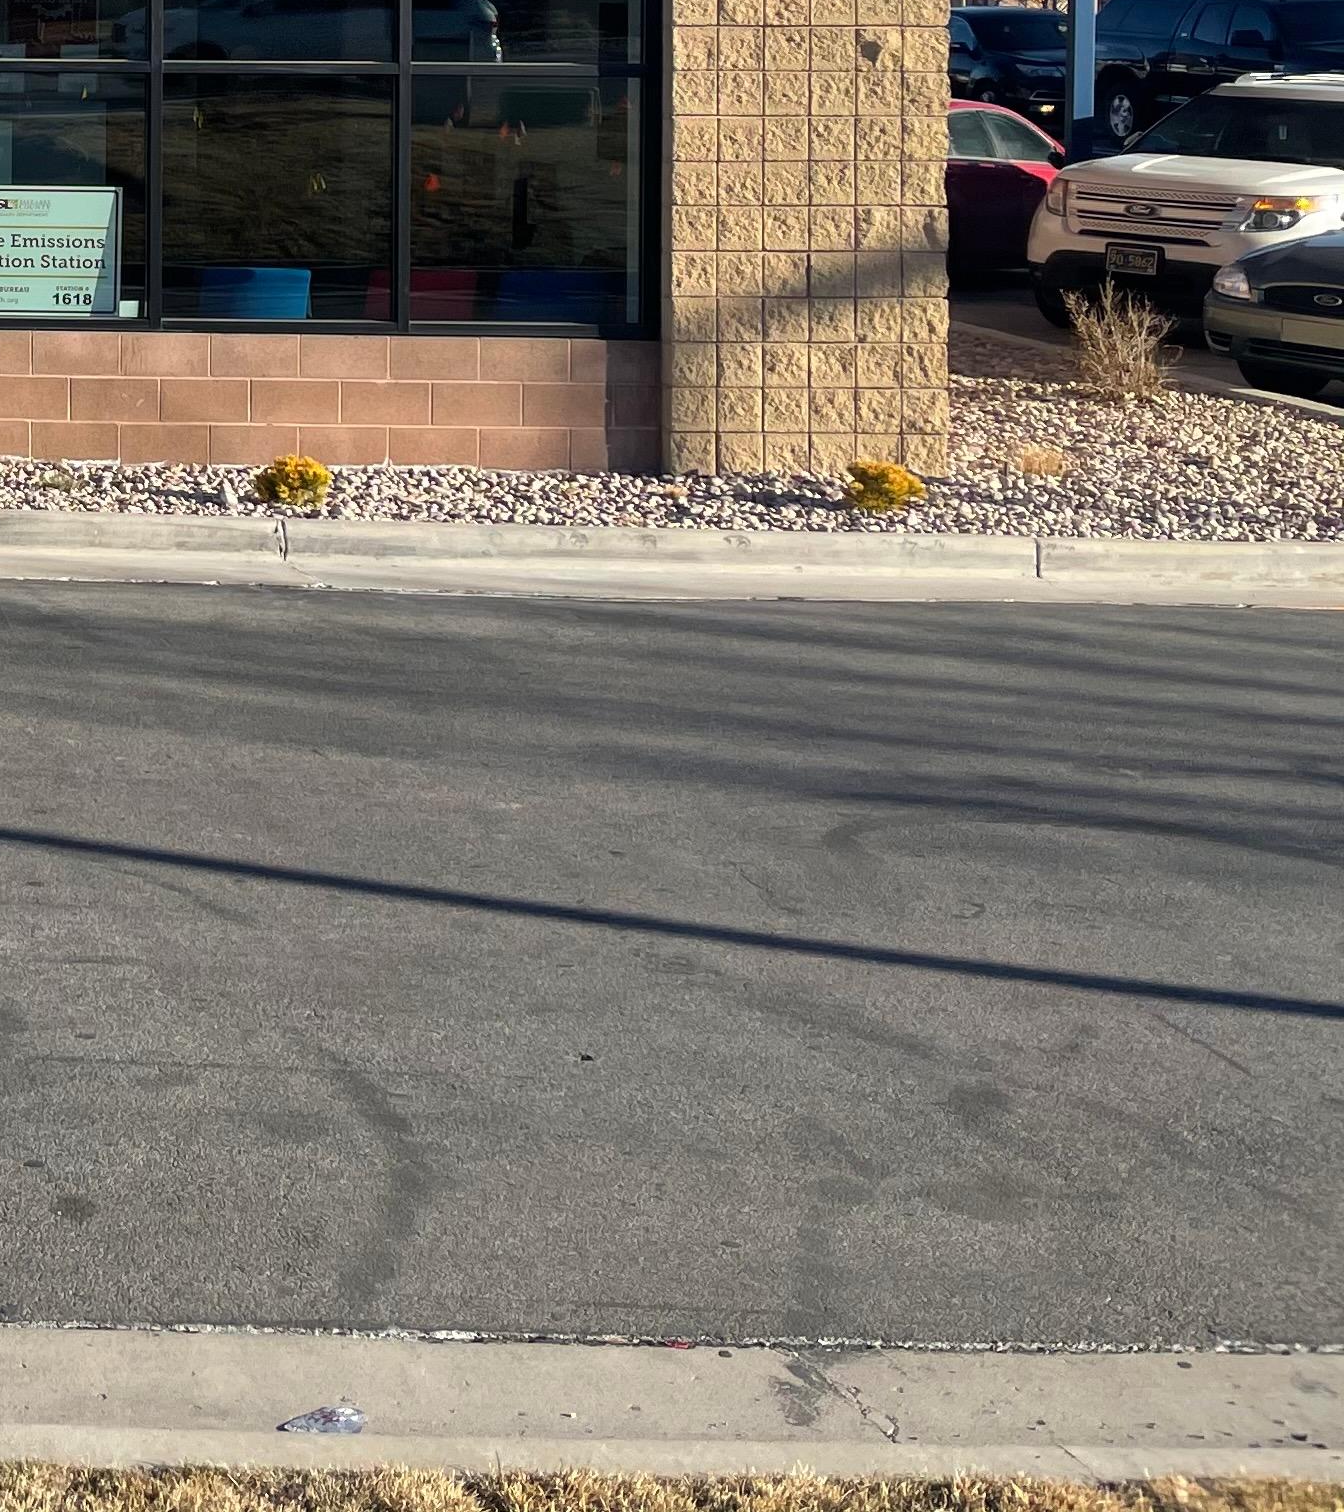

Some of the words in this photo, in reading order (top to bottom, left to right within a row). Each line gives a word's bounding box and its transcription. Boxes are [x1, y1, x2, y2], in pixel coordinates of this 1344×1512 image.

[10, 233, 106, 249] Emissions
[40, 254, 107, 269] Station
[52, 292, 92, 306] 1618
